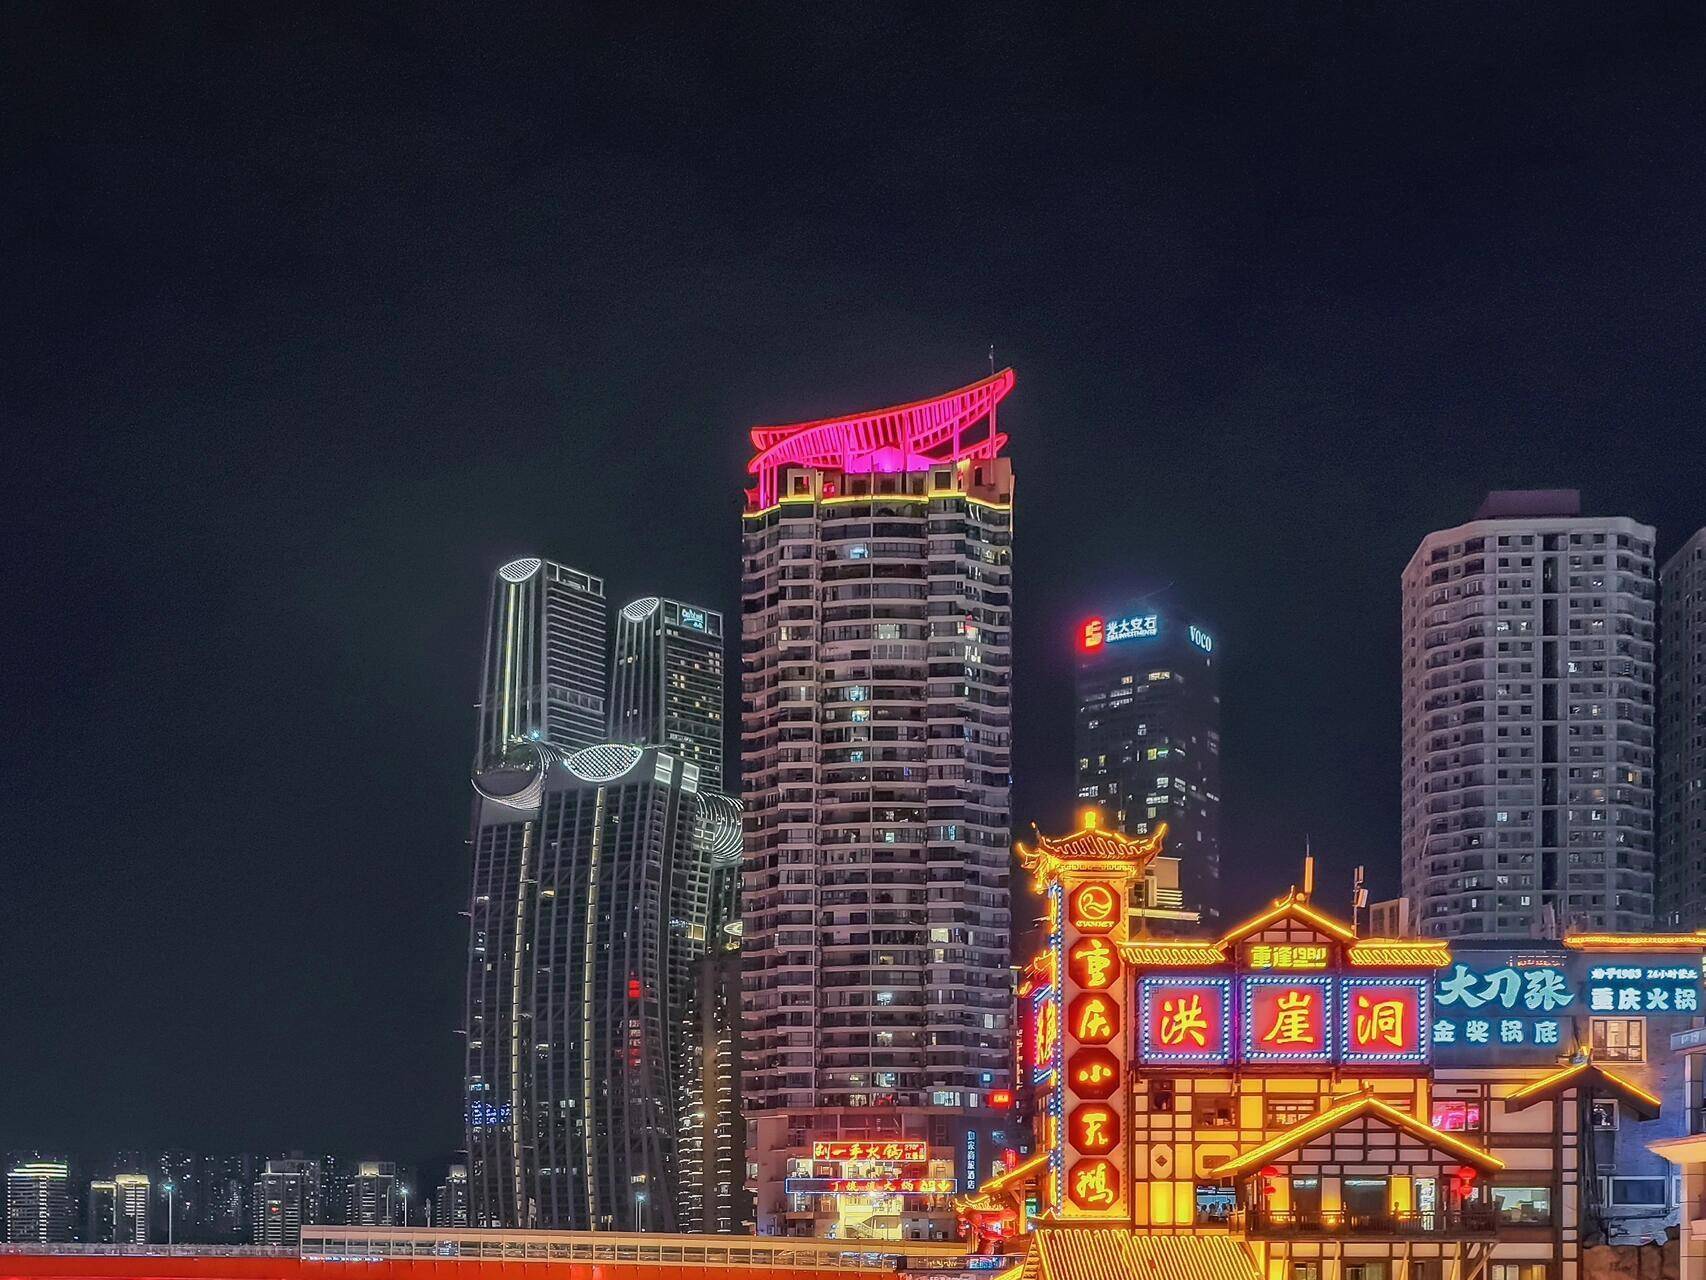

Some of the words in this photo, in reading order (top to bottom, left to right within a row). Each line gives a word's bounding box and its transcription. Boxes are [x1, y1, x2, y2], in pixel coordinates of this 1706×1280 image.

[1434, 963, 1575, 1011] 大刀张
[1590, 987, 1697, 1011] 重庆火锅
[1160, 990, 1404, 1047] 洪崖洞
[1433, 1019, 1558, 1043] 金奖锅底
